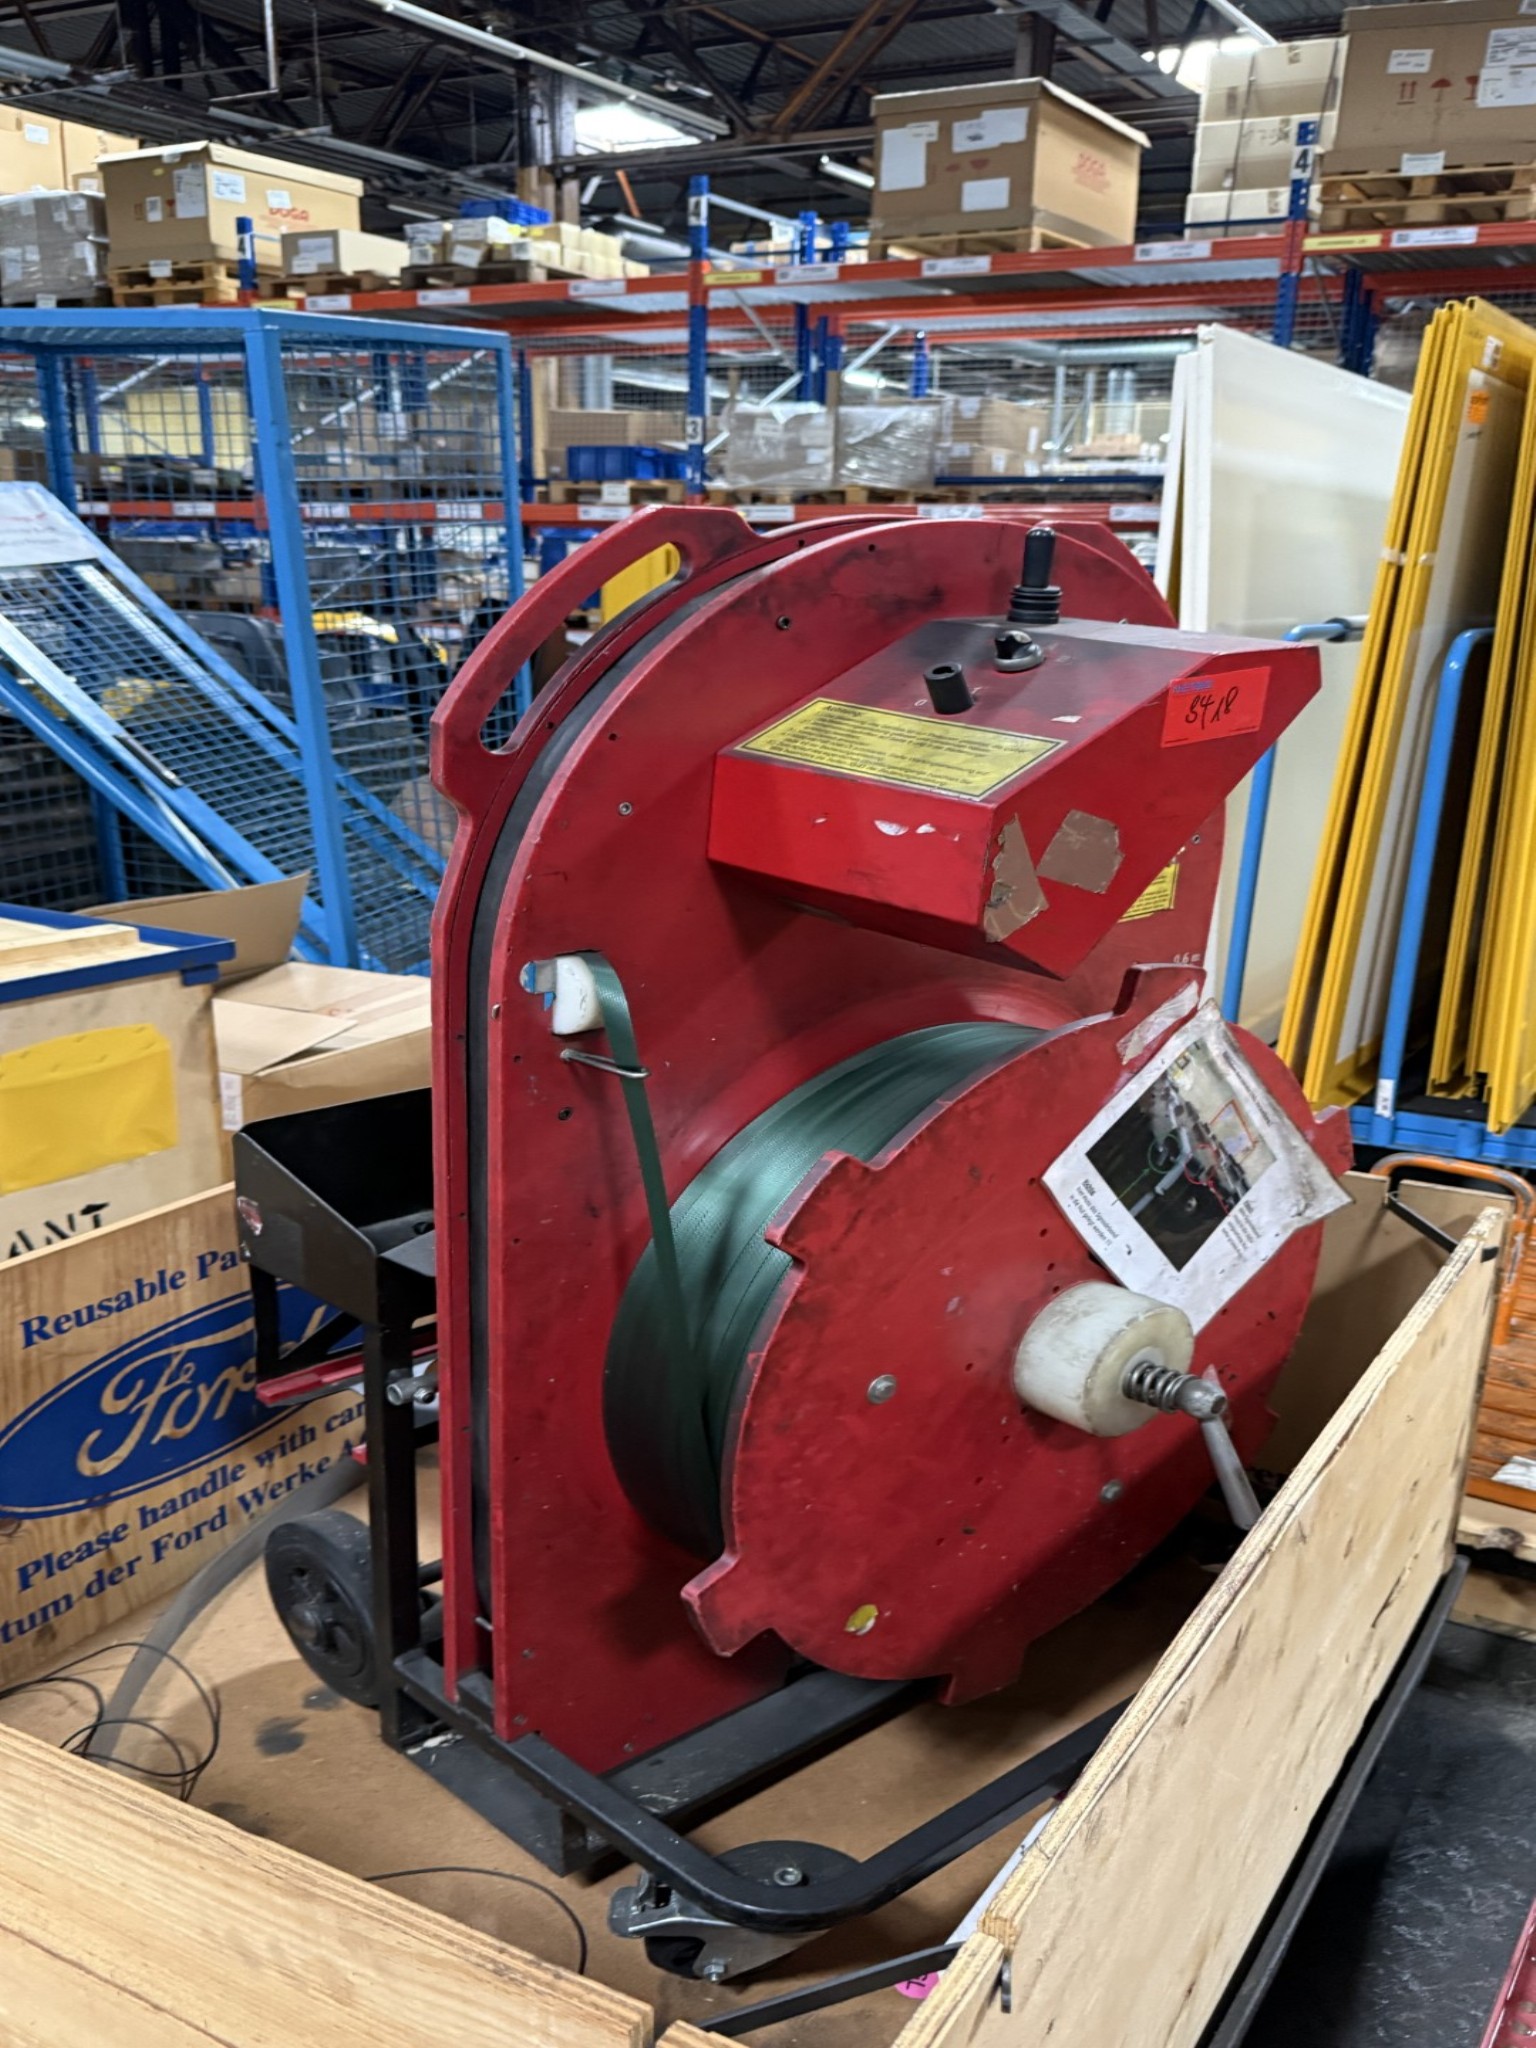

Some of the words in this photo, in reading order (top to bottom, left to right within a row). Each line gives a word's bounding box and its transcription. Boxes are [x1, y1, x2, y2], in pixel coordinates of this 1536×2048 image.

[1294, 148, 1311, 174] 4
[687, 419, 699, 441] 3
[20, 1269, 186, 1350] Reusable
[16, 1523, 129, 1593] Please
[137, 1463, 246, 1531] handle
[254, 1424, 317, 1469] with
[0, 1593, 74, 1644] tum
[84, 1555, 143, 1599] der
[151, 1504, 228, 1565] Ford
[236, 1456, 331, 1514] Werke
